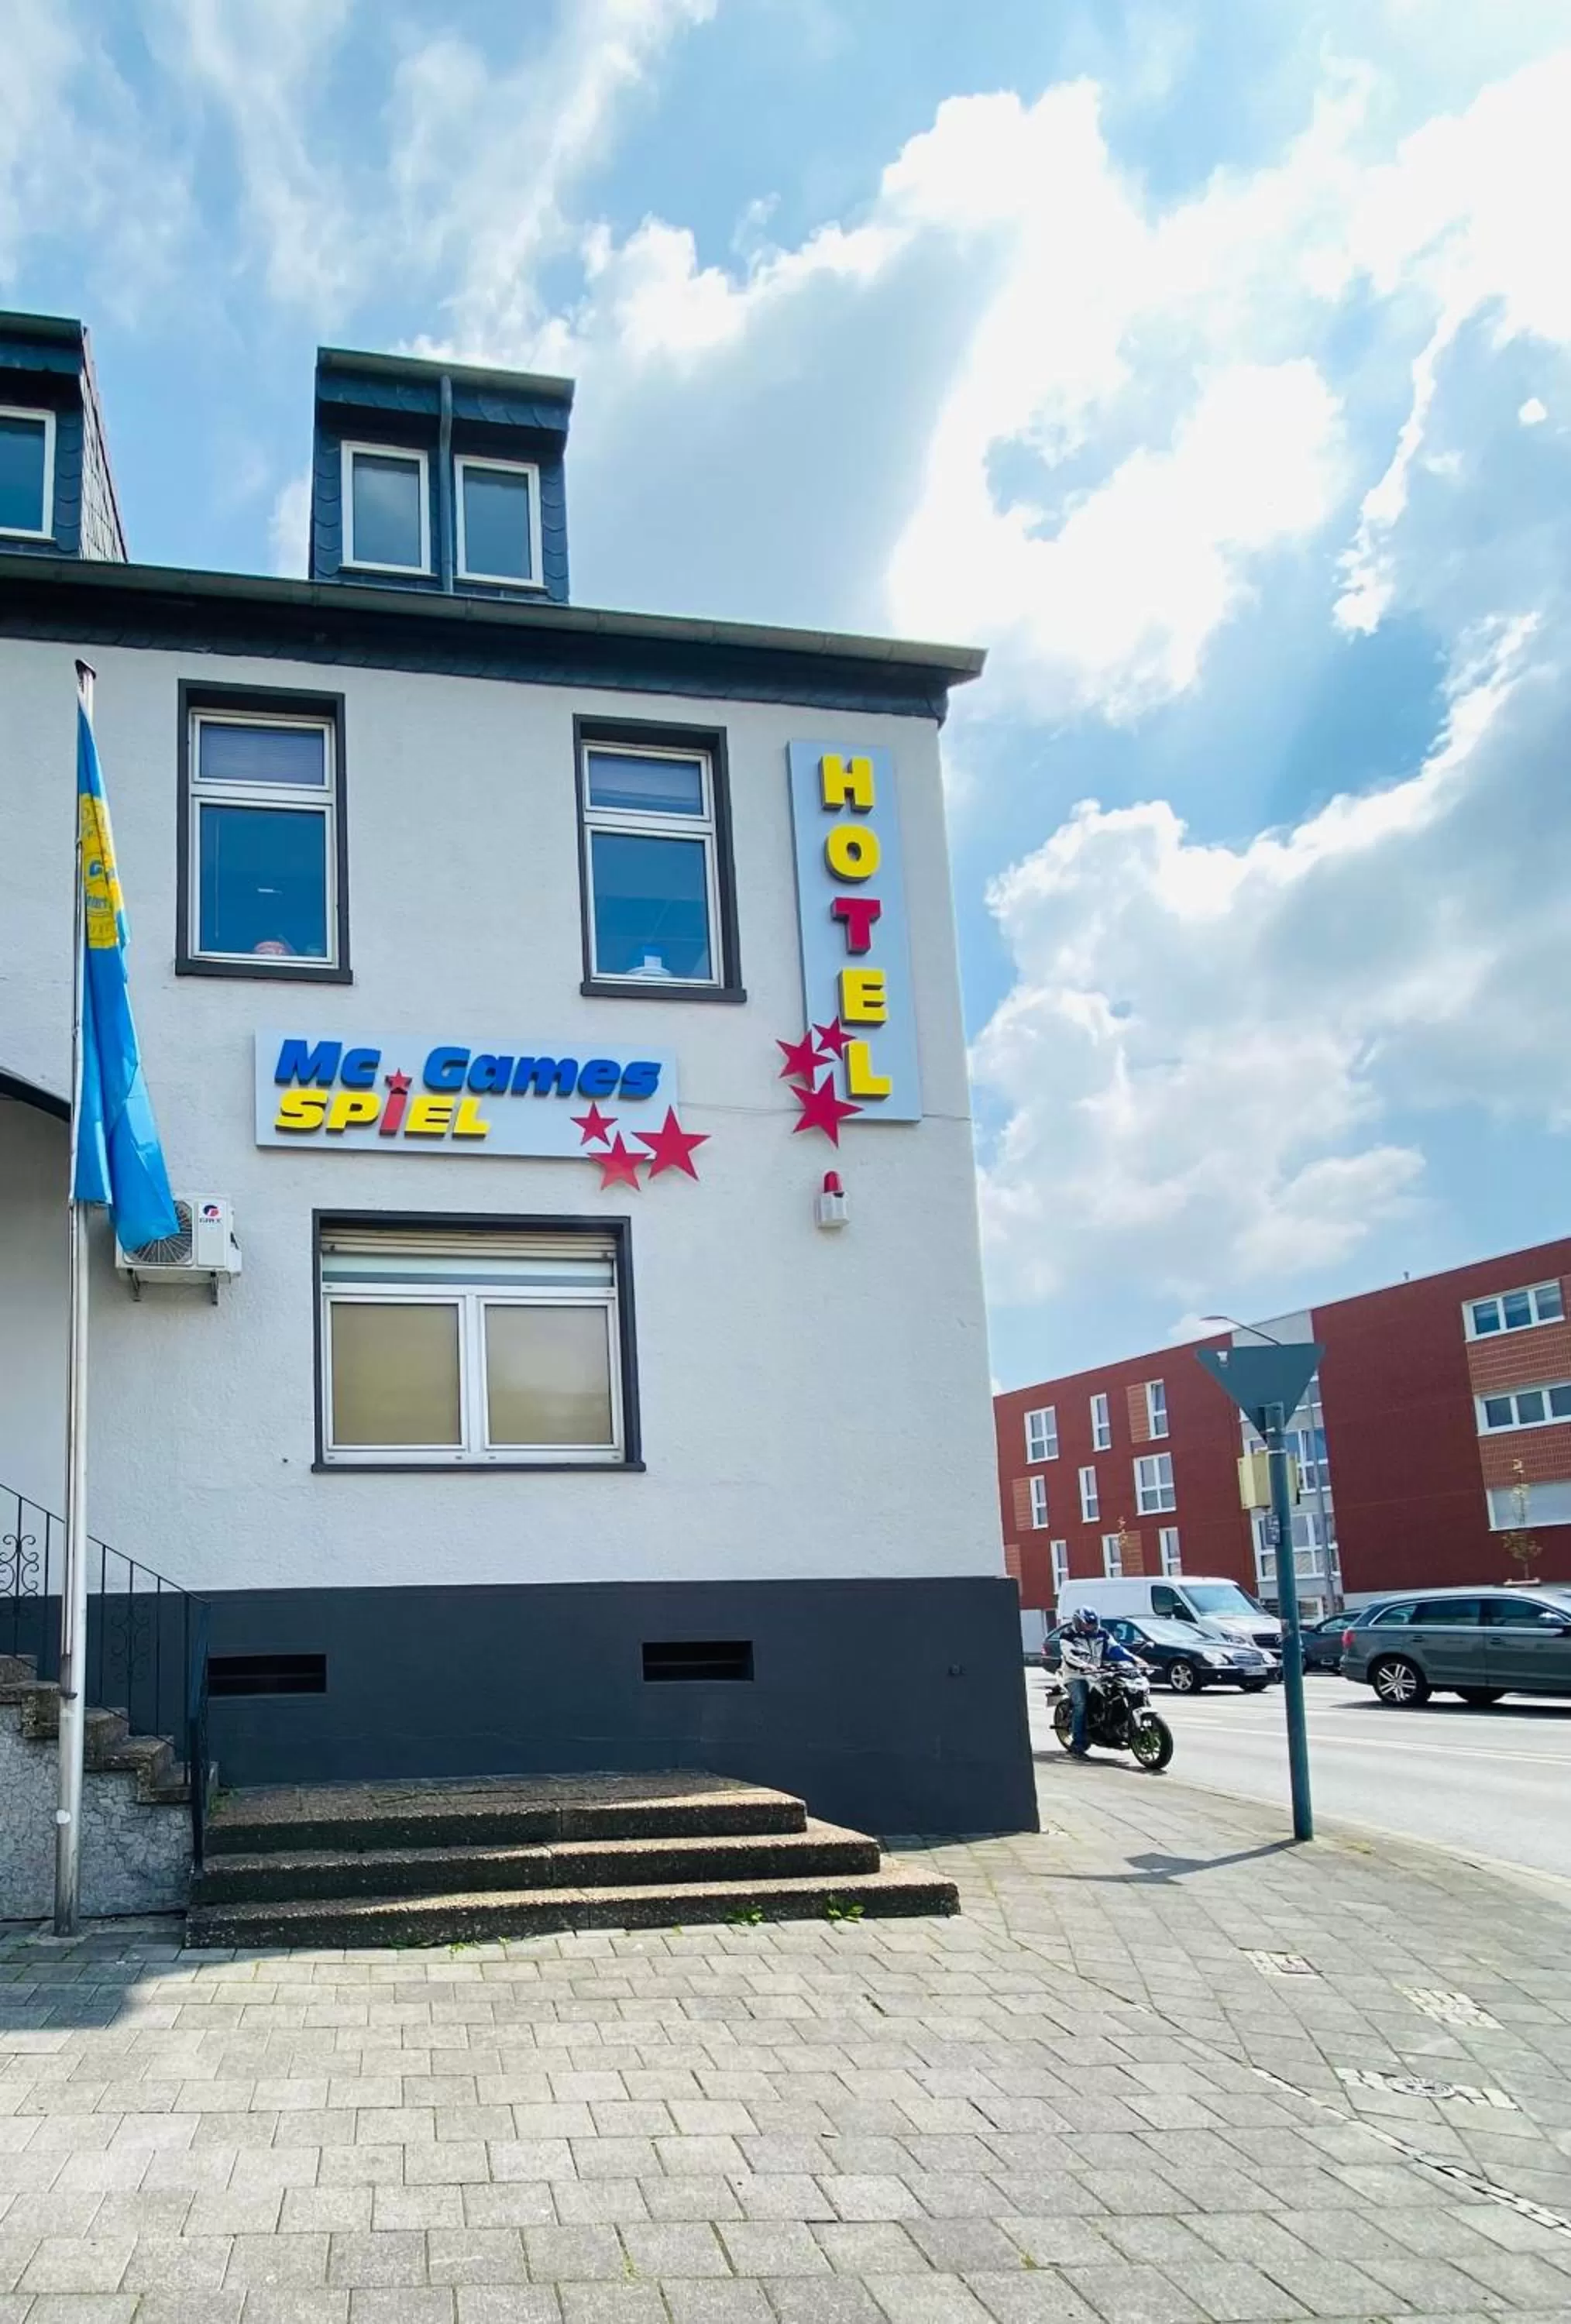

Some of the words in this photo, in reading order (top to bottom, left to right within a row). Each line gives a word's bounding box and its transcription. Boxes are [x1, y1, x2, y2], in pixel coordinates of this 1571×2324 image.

[820, 754, 892, 1100] HOTEL
[274, 1039, 381, 1088] Mc
[423, 1047, 662, 1098] Games
